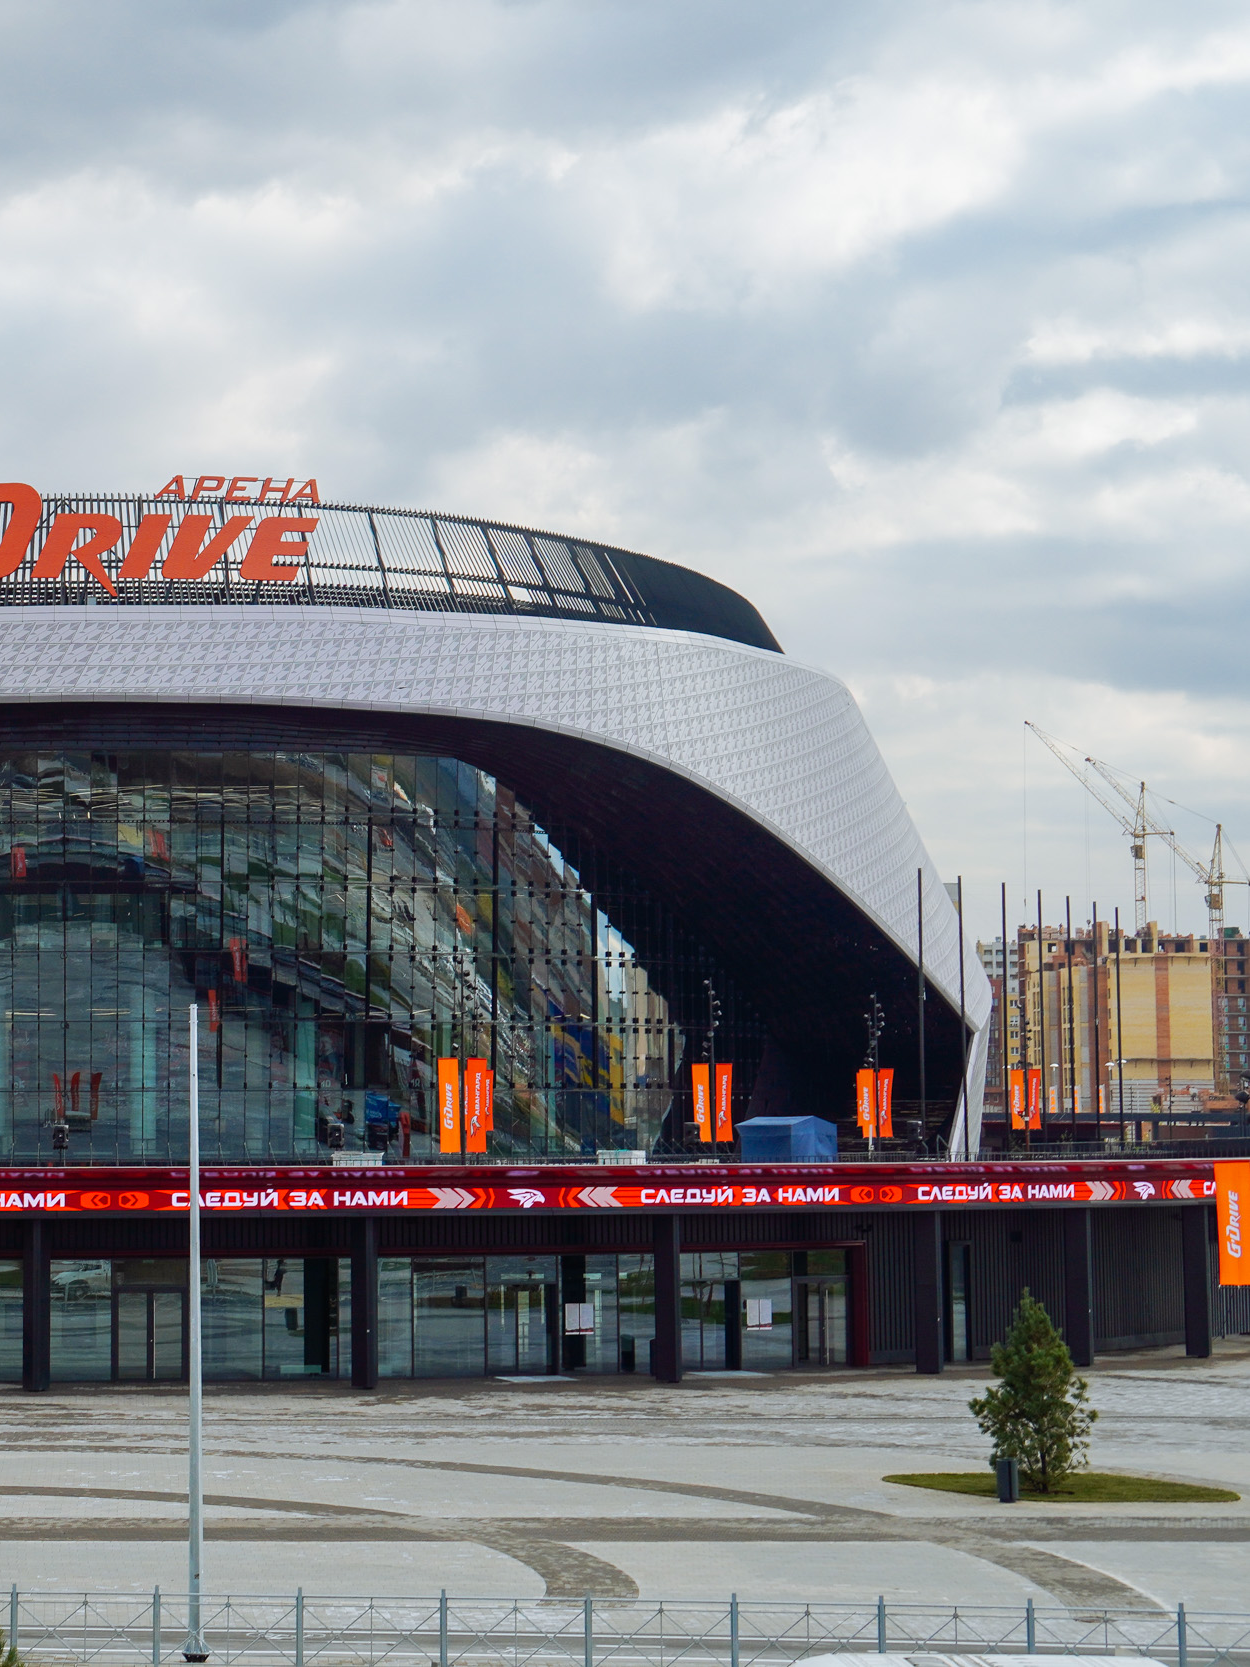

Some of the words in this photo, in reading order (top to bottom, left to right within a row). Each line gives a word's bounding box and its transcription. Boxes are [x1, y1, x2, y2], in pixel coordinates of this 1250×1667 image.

[154, 474, 320, 503] АРЕНА
[289, 1192, 324, 1206] ЗА
[334, 1191, 408, 1206] НАМИ
[641, 1186, 732, 1204] СЛЕДУЙ
[742, 1189, 771, 1203] ЗА
[779, 1187, 839, 1203] НАМИ
[918, 1183, 991, 1201] СЛЕДУЙ
[999, 1185, 1023, 1199] ЗА
[1028, 1184, 1074, 1199] НАМИ
